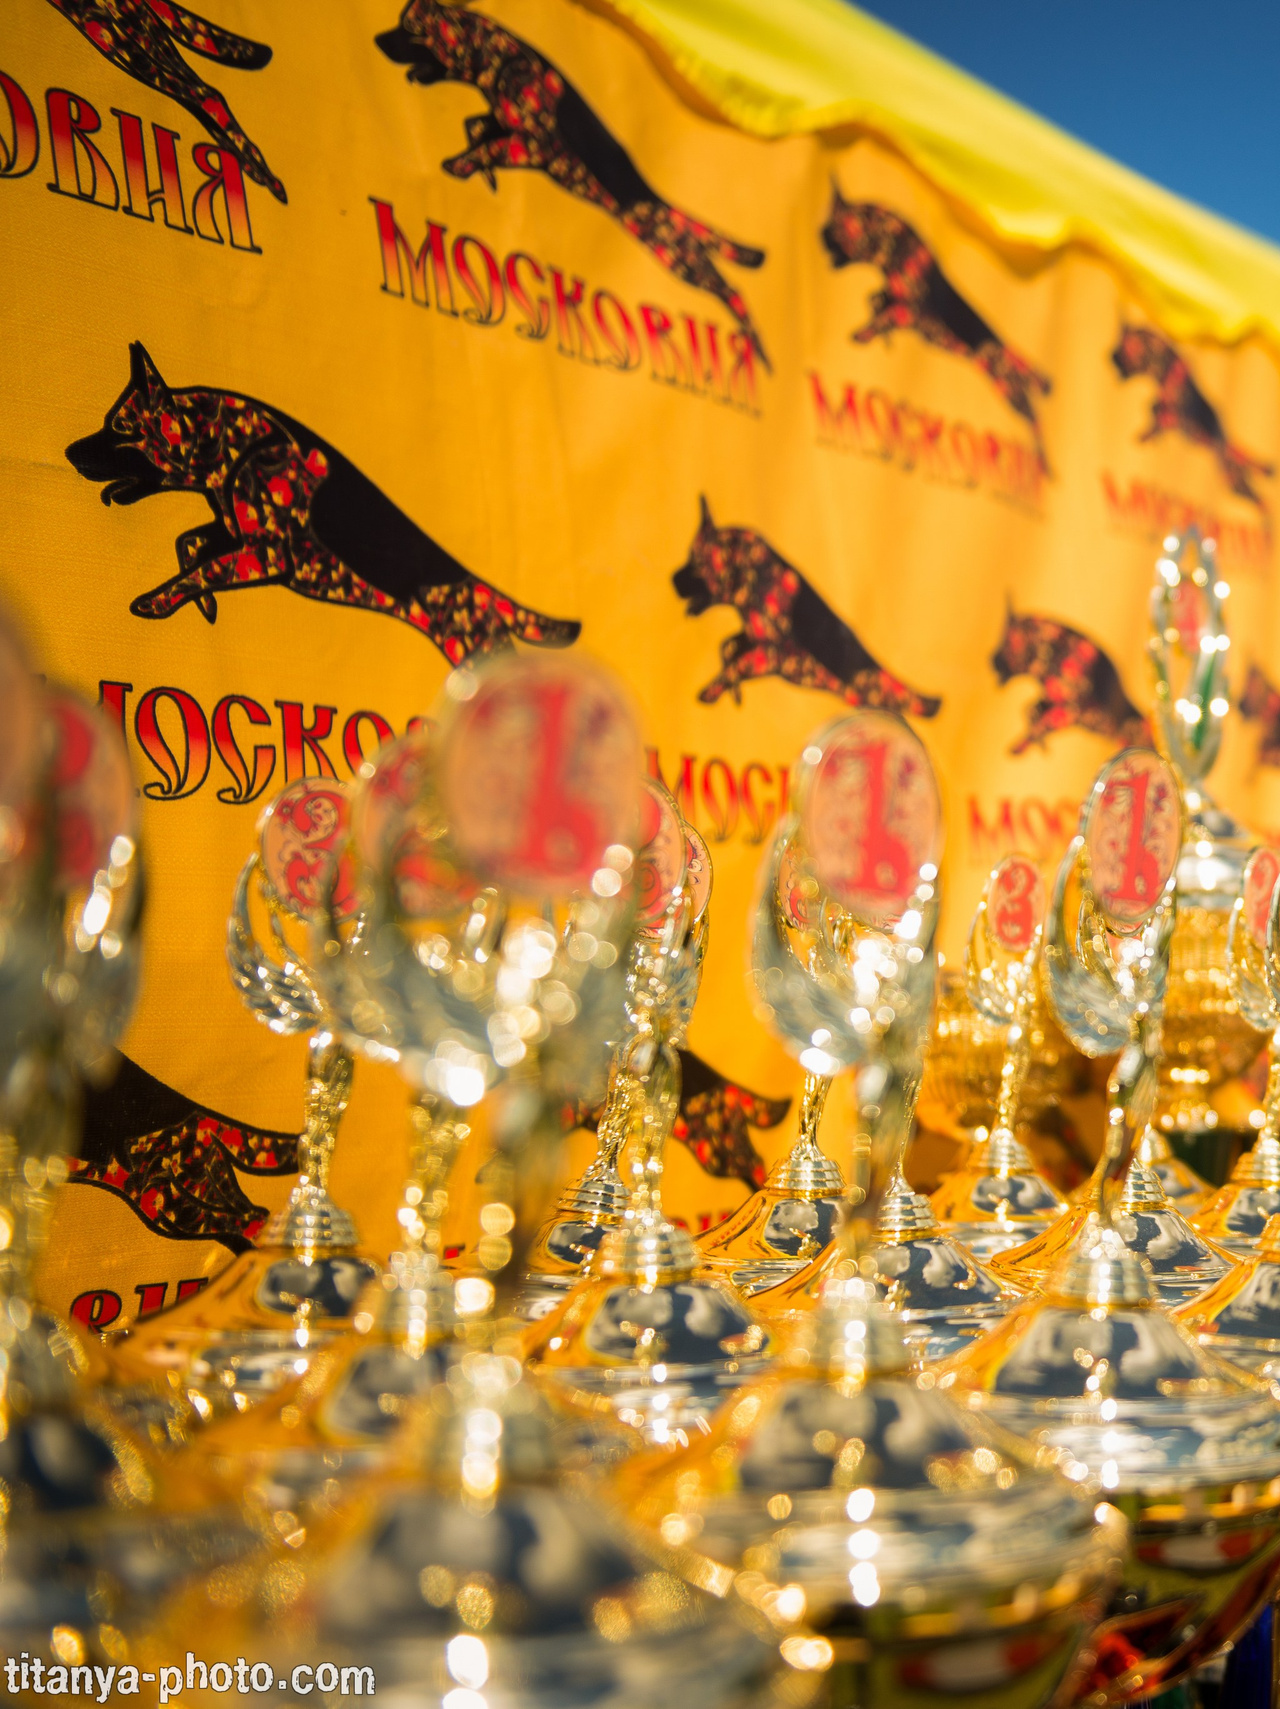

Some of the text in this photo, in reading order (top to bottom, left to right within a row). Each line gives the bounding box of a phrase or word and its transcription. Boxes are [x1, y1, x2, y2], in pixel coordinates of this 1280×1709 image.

[368, 195, 763, 420] МОСКОВИЯ
[825, 742, 912, 898] 1
[1102, 769, 1160, 906] 1
[997, 862, 1037, 946] 3
